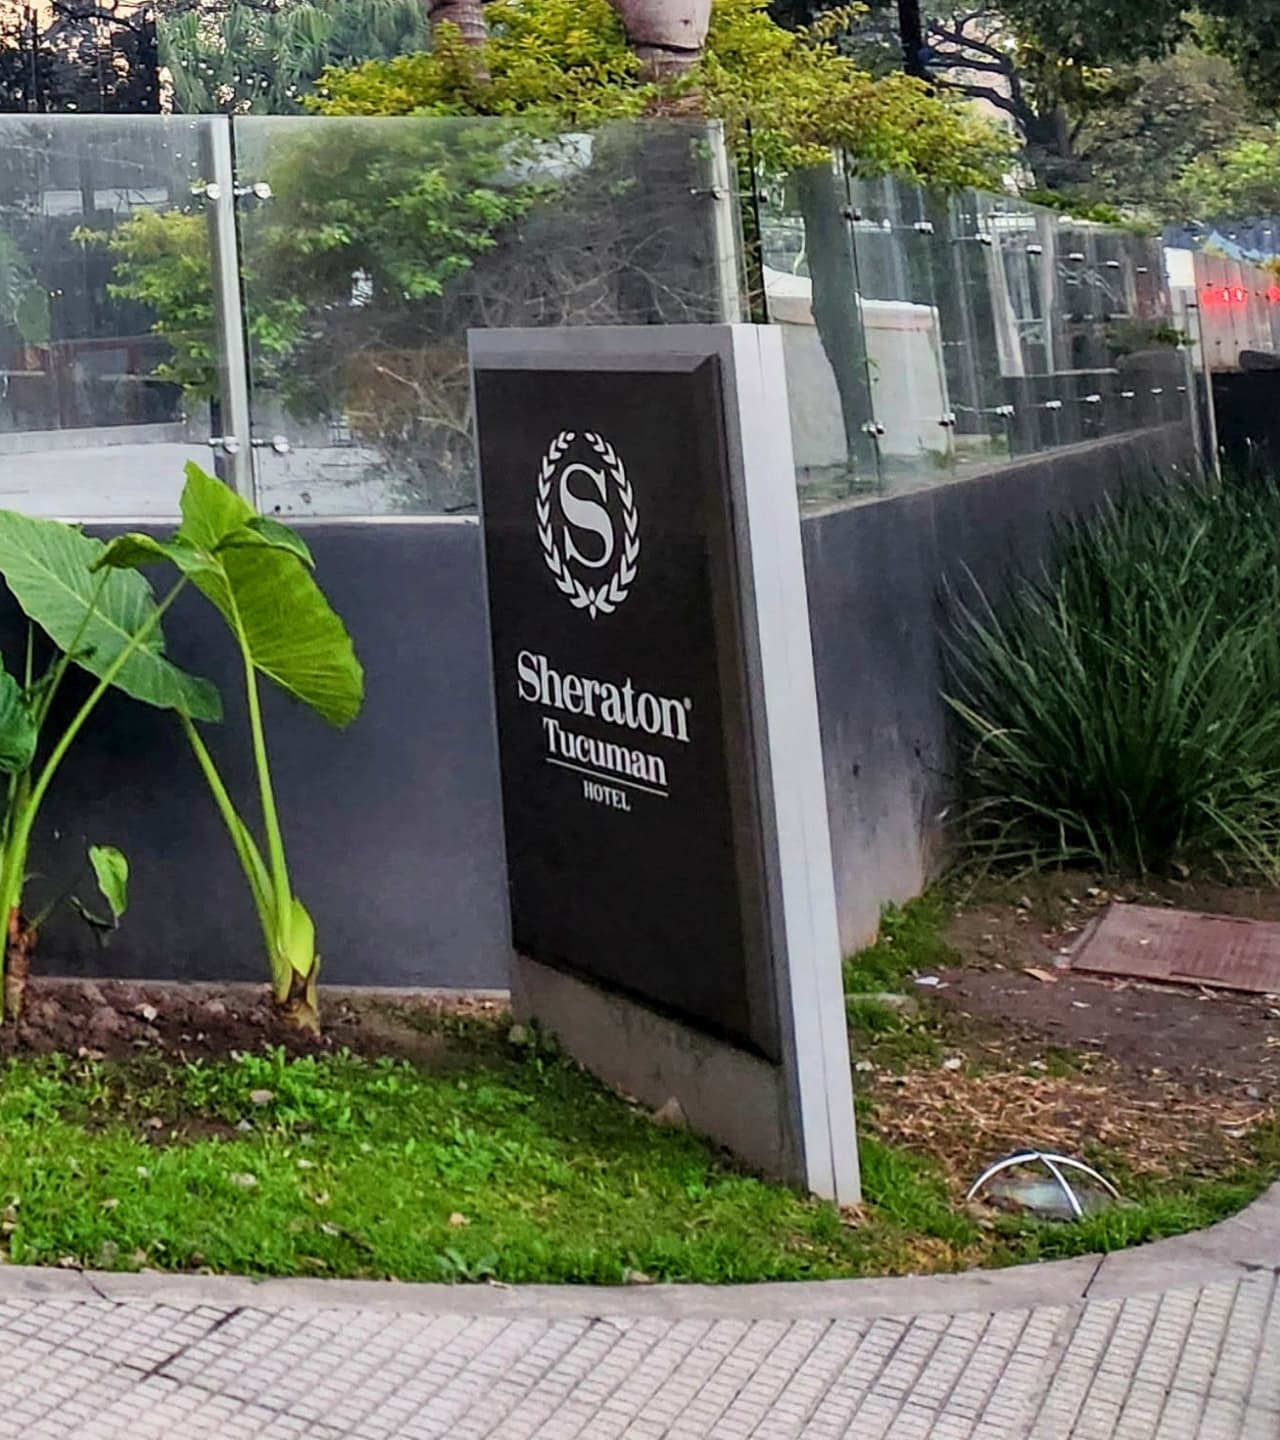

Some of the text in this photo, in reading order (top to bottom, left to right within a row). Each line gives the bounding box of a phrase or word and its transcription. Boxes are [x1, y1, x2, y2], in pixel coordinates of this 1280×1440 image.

[558, 462, 615, 569] S
[517, 649, 691, 744] Sheraton
[542, 716, 669, 786] Tucuman
[582, 779, 632, 812] HOTEL
